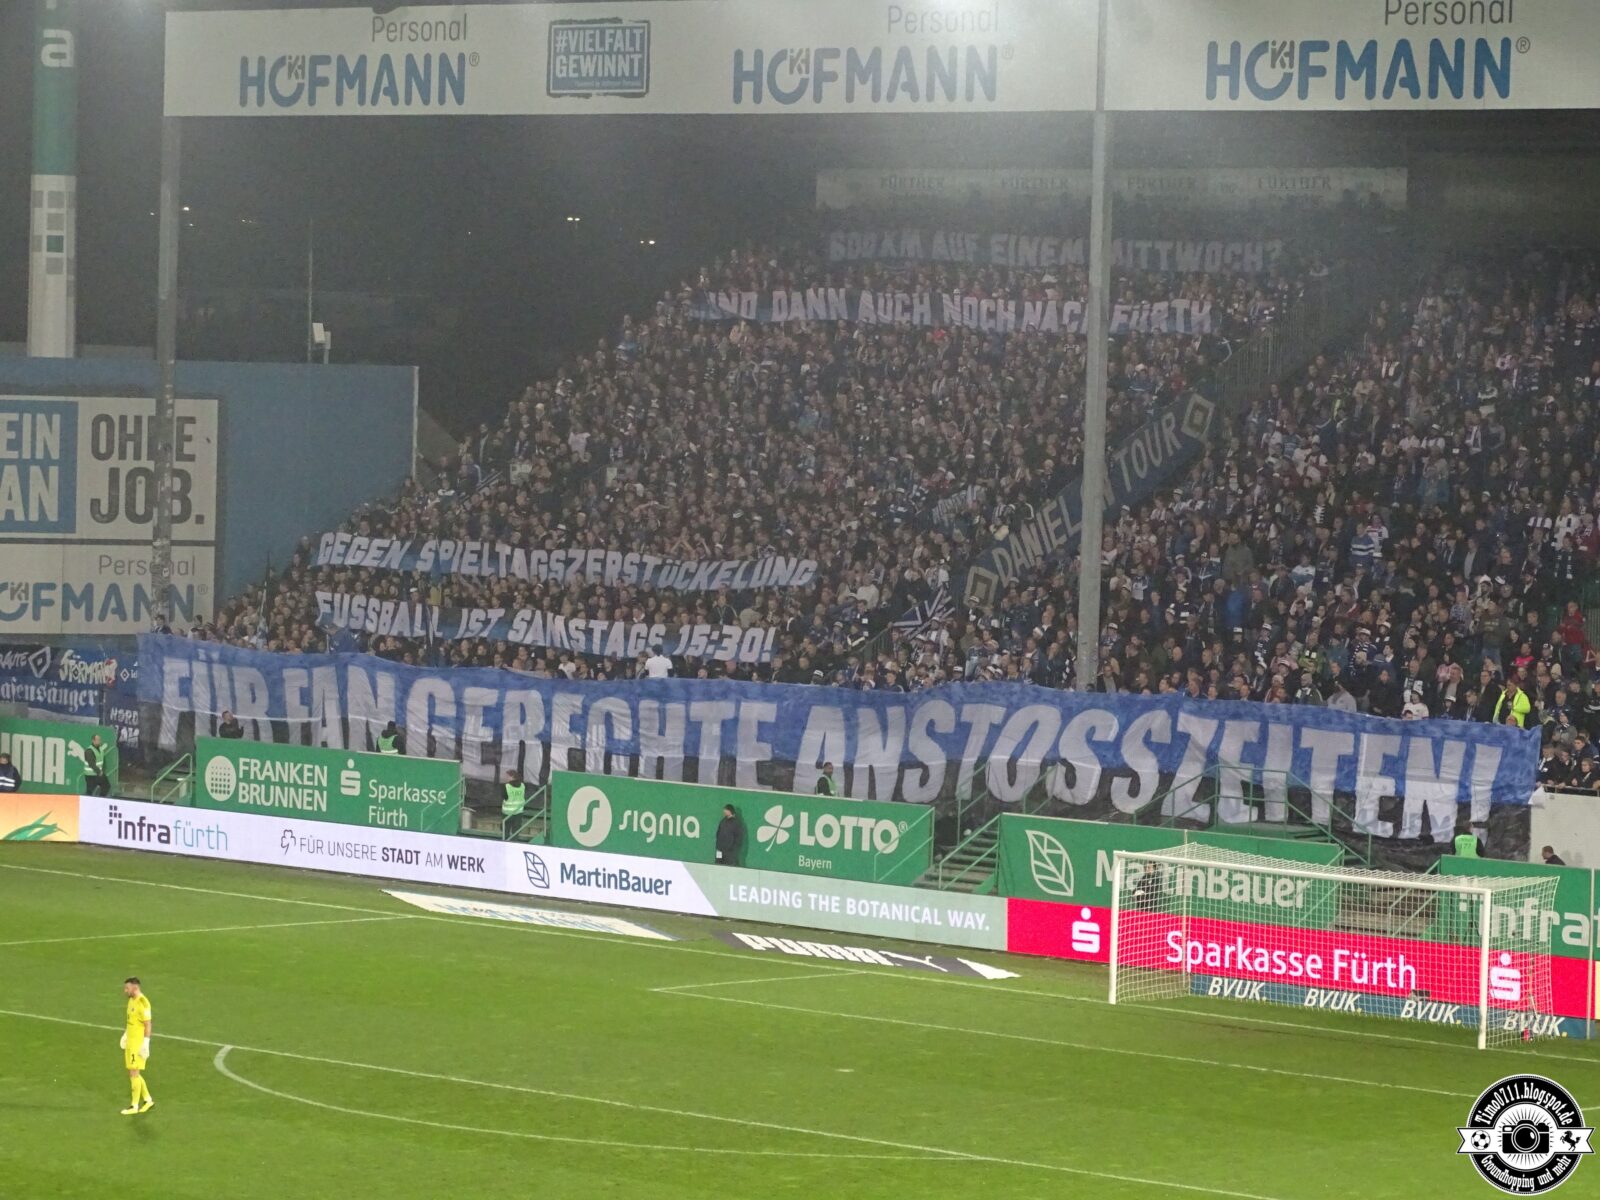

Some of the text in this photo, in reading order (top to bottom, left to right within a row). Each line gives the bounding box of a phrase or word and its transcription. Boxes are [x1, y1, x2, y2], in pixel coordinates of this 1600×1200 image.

[371, 13, 467, 42] Personal
[887, 5, 999, 34] Personal
[1384, 0, 1513, 26] Personal
[555, 28, 644, 53] #VIELFALT
[555, 53, 643, 78] GEWINNT
[770, 288, 848, 322] DANN
[858, 289, 932, 325] AUCH
[942, 292, 1016, 331] NOCH
[1022, 299, 1090, 334] NAC
[0, 413, 61, 460] EIN
[317, 531, 411, 570] GEGEN
[315, 590, 443, 638] FUSSBALL
[454, 607, 505, 640] IST
[238, 757, 328, 787] FRANKEN
[238, 782, 328, 812] BRUNNEN
[368, 779, 447, 805] Sparkasse
[368, 805, 408, 828] Fürth
[618, 809, 700, 843] signia
[299, 834, 485, 874] FÜR UNSERE STADT AM WERK
[798, 855, 832, 871] Bayern
[560, 862, 672, 897] MartinBauer
[729, 883, 990, 932] LEADING THE BOTANICAL WAY.
[732, 932, 902, 967] PUMA
[1166, 930, 1416, 990] Sparkasse Fürth
[1208, 976, 1267, 1001] BVUK.
[1303, 987, 1362, 1013] BVUK.
[1401, 1000, 1462, 1025] BVUK.
